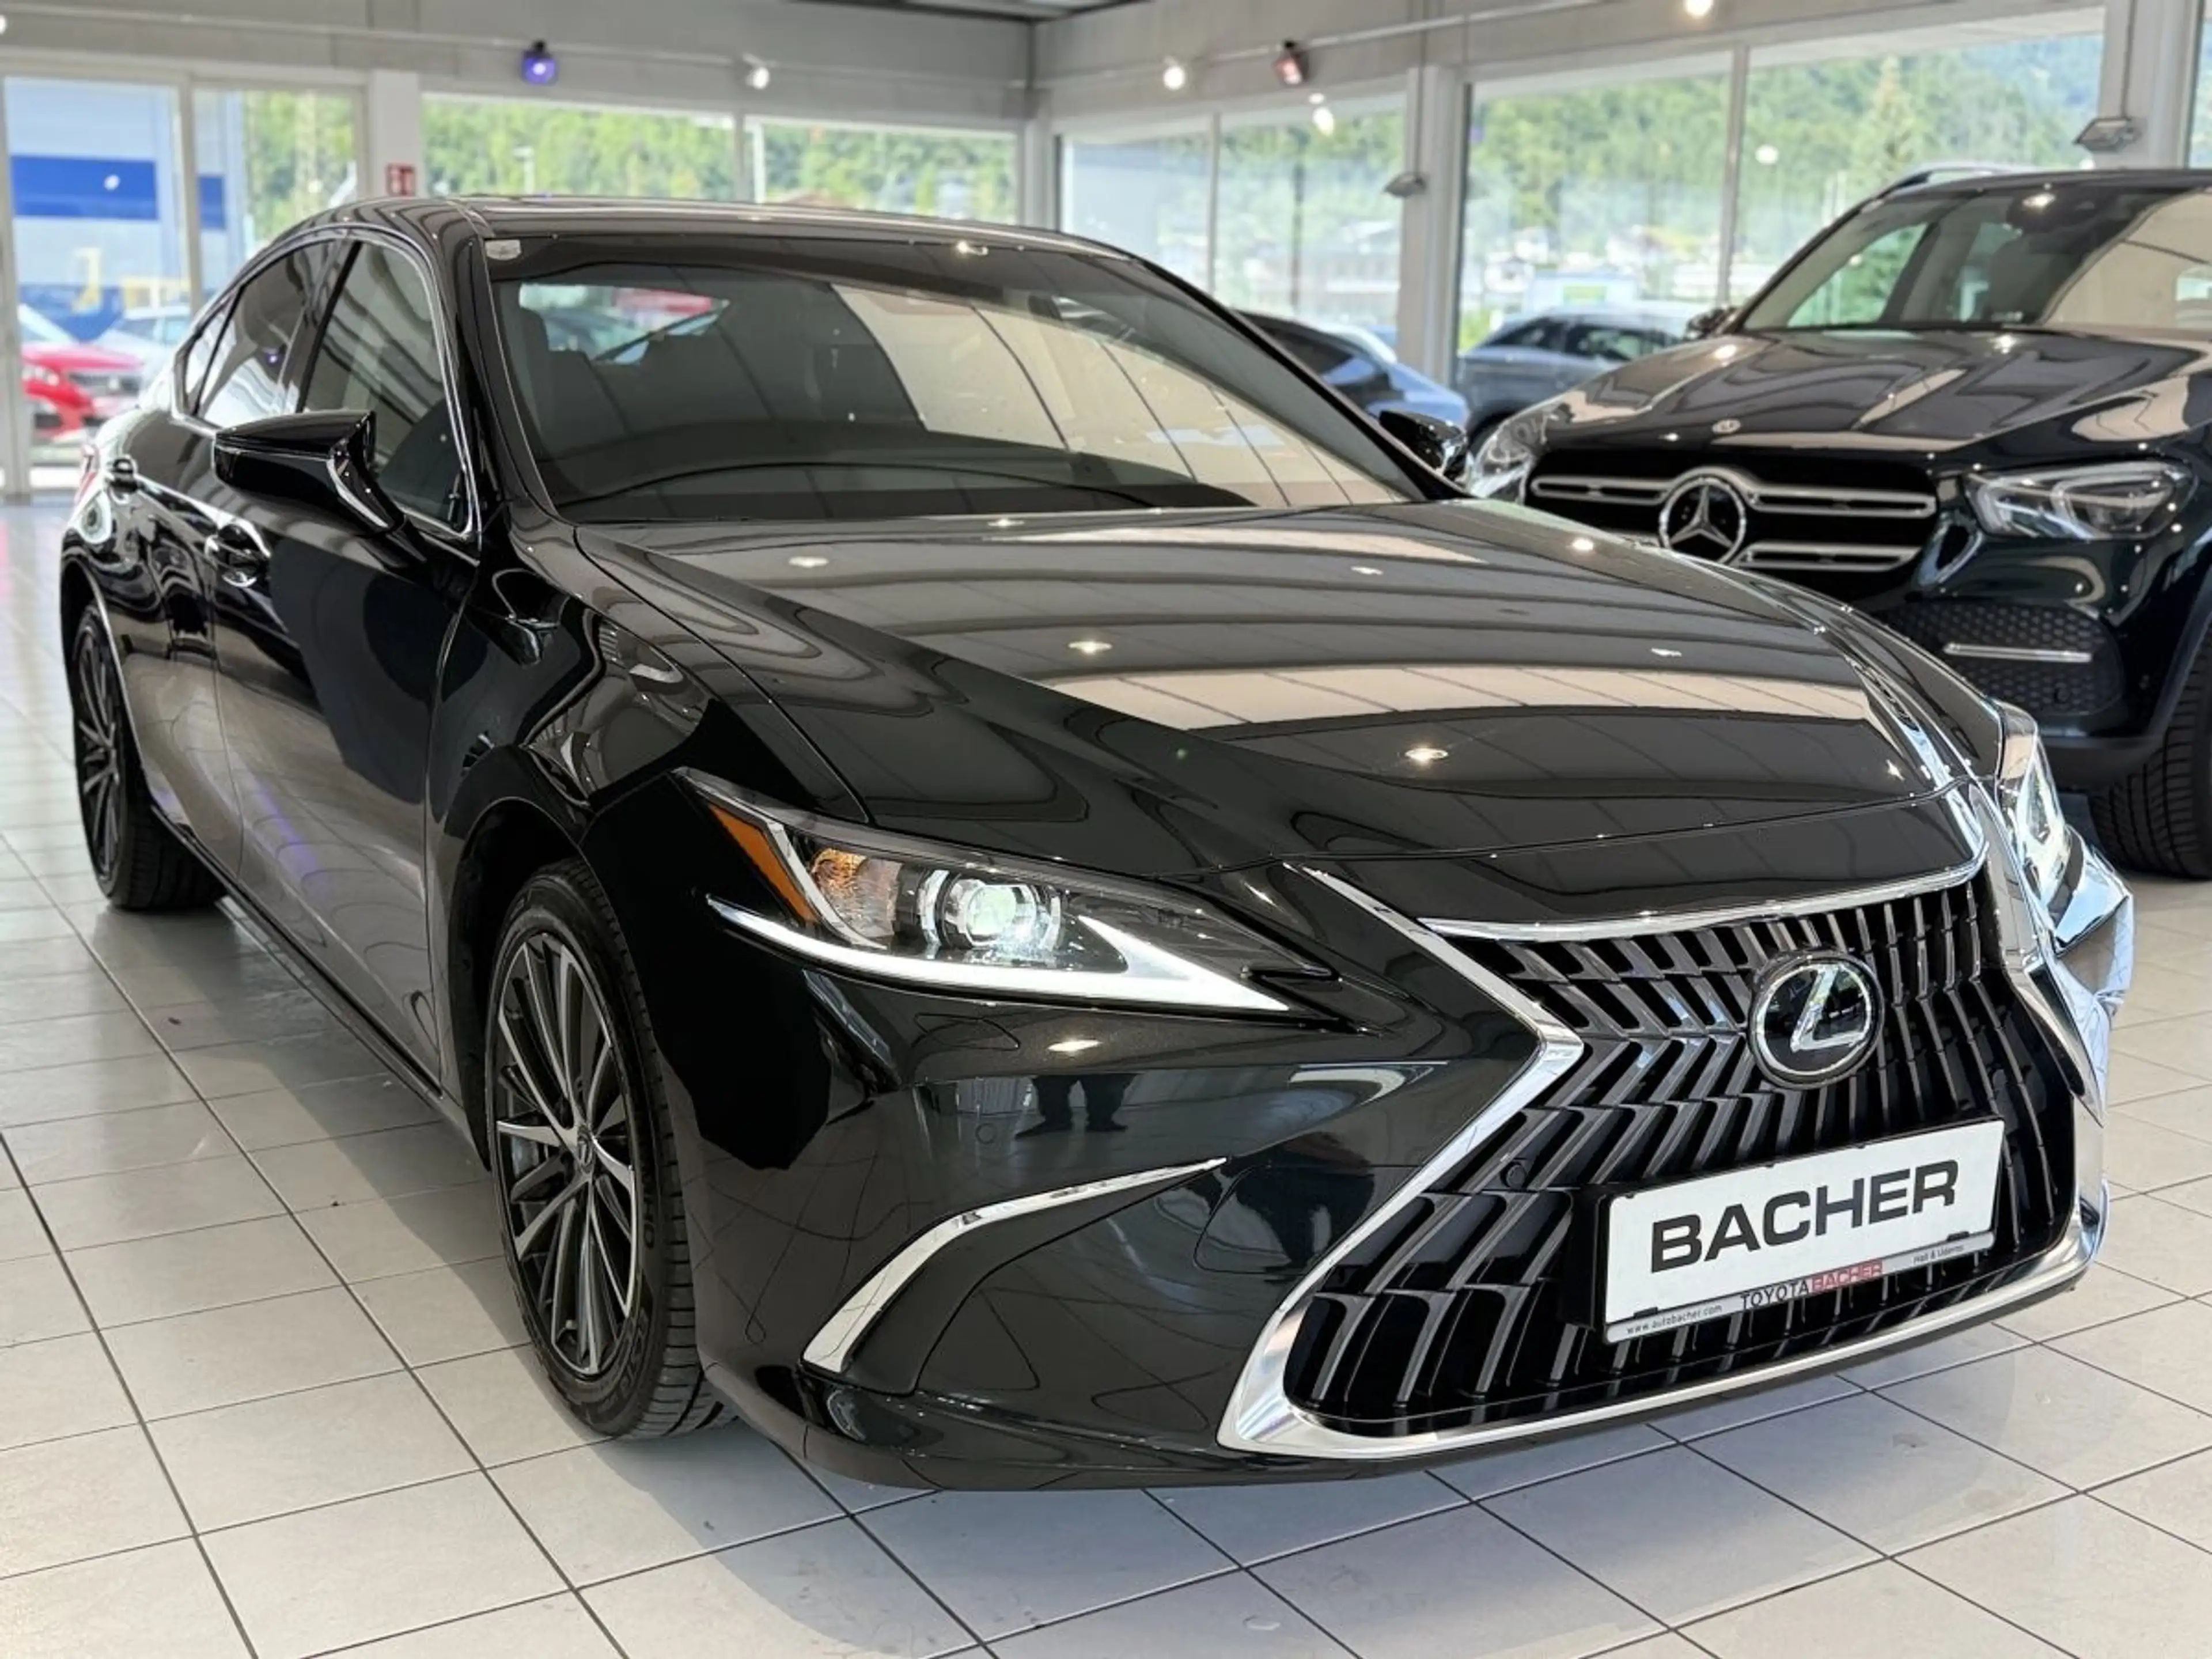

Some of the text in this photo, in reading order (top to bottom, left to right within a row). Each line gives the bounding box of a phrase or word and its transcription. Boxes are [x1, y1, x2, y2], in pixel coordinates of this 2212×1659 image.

[1651, 1159, 1959, 1273] BACHER
[1740, 1260, 1883, 1310] TOYOTA BACHER
